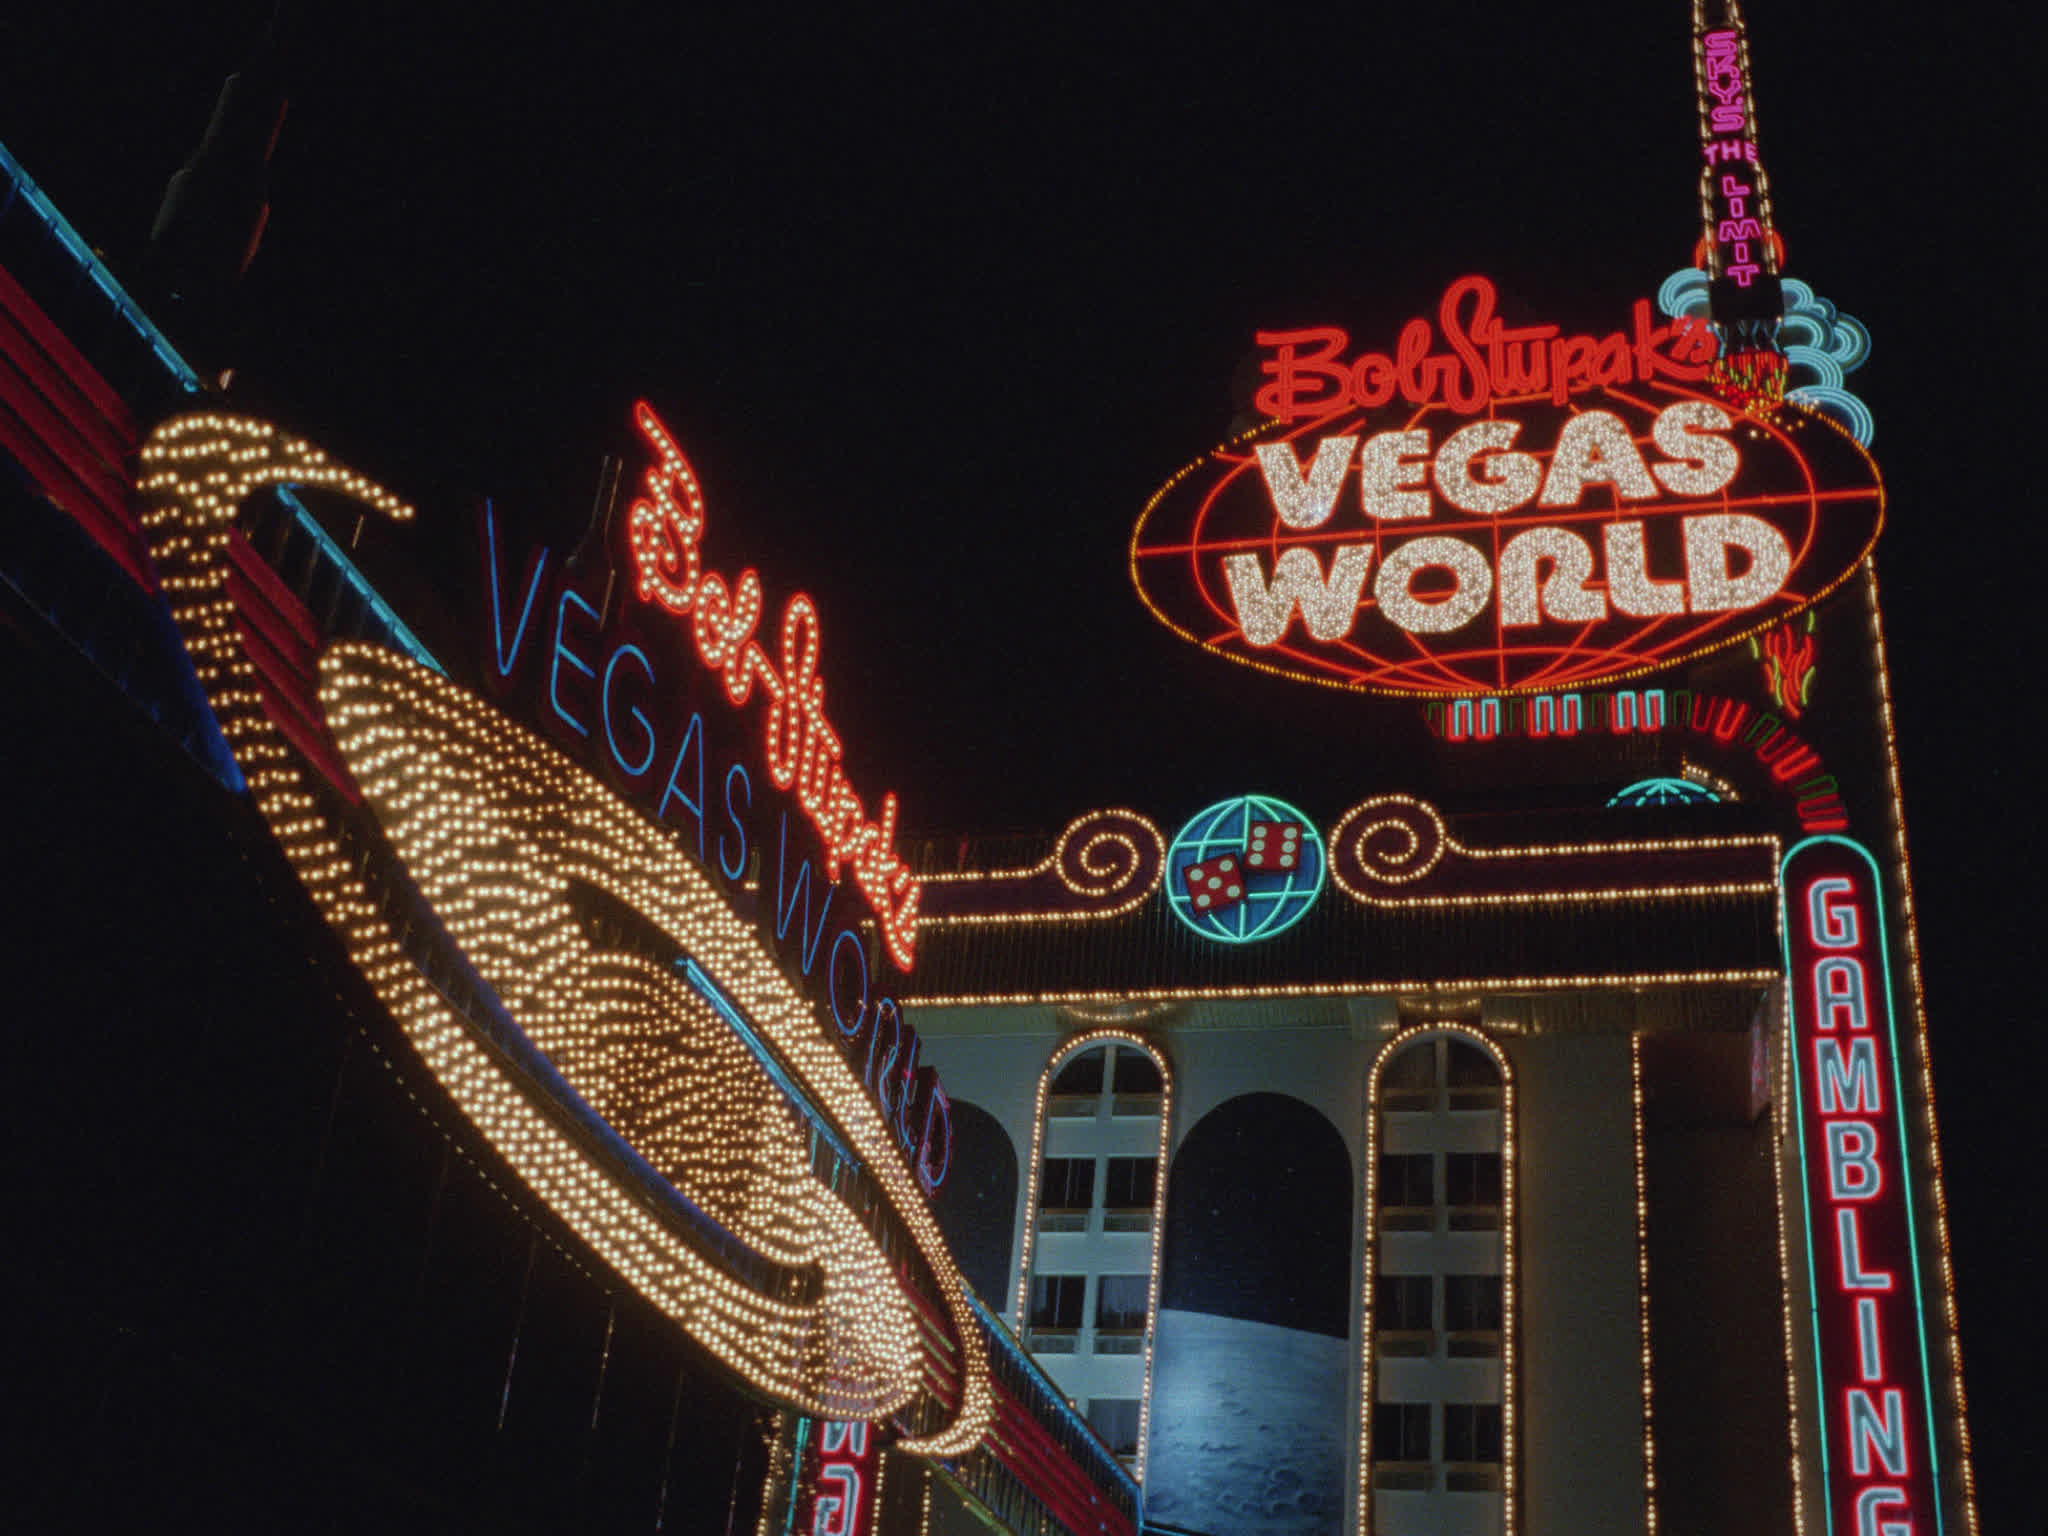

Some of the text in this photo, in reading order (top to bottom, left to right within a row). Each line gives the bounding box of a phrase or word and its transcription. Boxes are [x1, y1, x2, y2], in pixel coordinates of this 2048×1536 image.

[1704, 140, 1757, 165] THE
[1718, 175, 1761, 287] LIMIT
[1255, 317, 1437, 424] Bob
[1254, 400, 1740, 529] VEGAS
[630, 400, 764, 705] Bob
[1222, 513, 1792, 646] WORLD
[486, 497, 952, 1190] VEGAS WORLD
[1806, 876, 1911, 1536] GAMBLING
